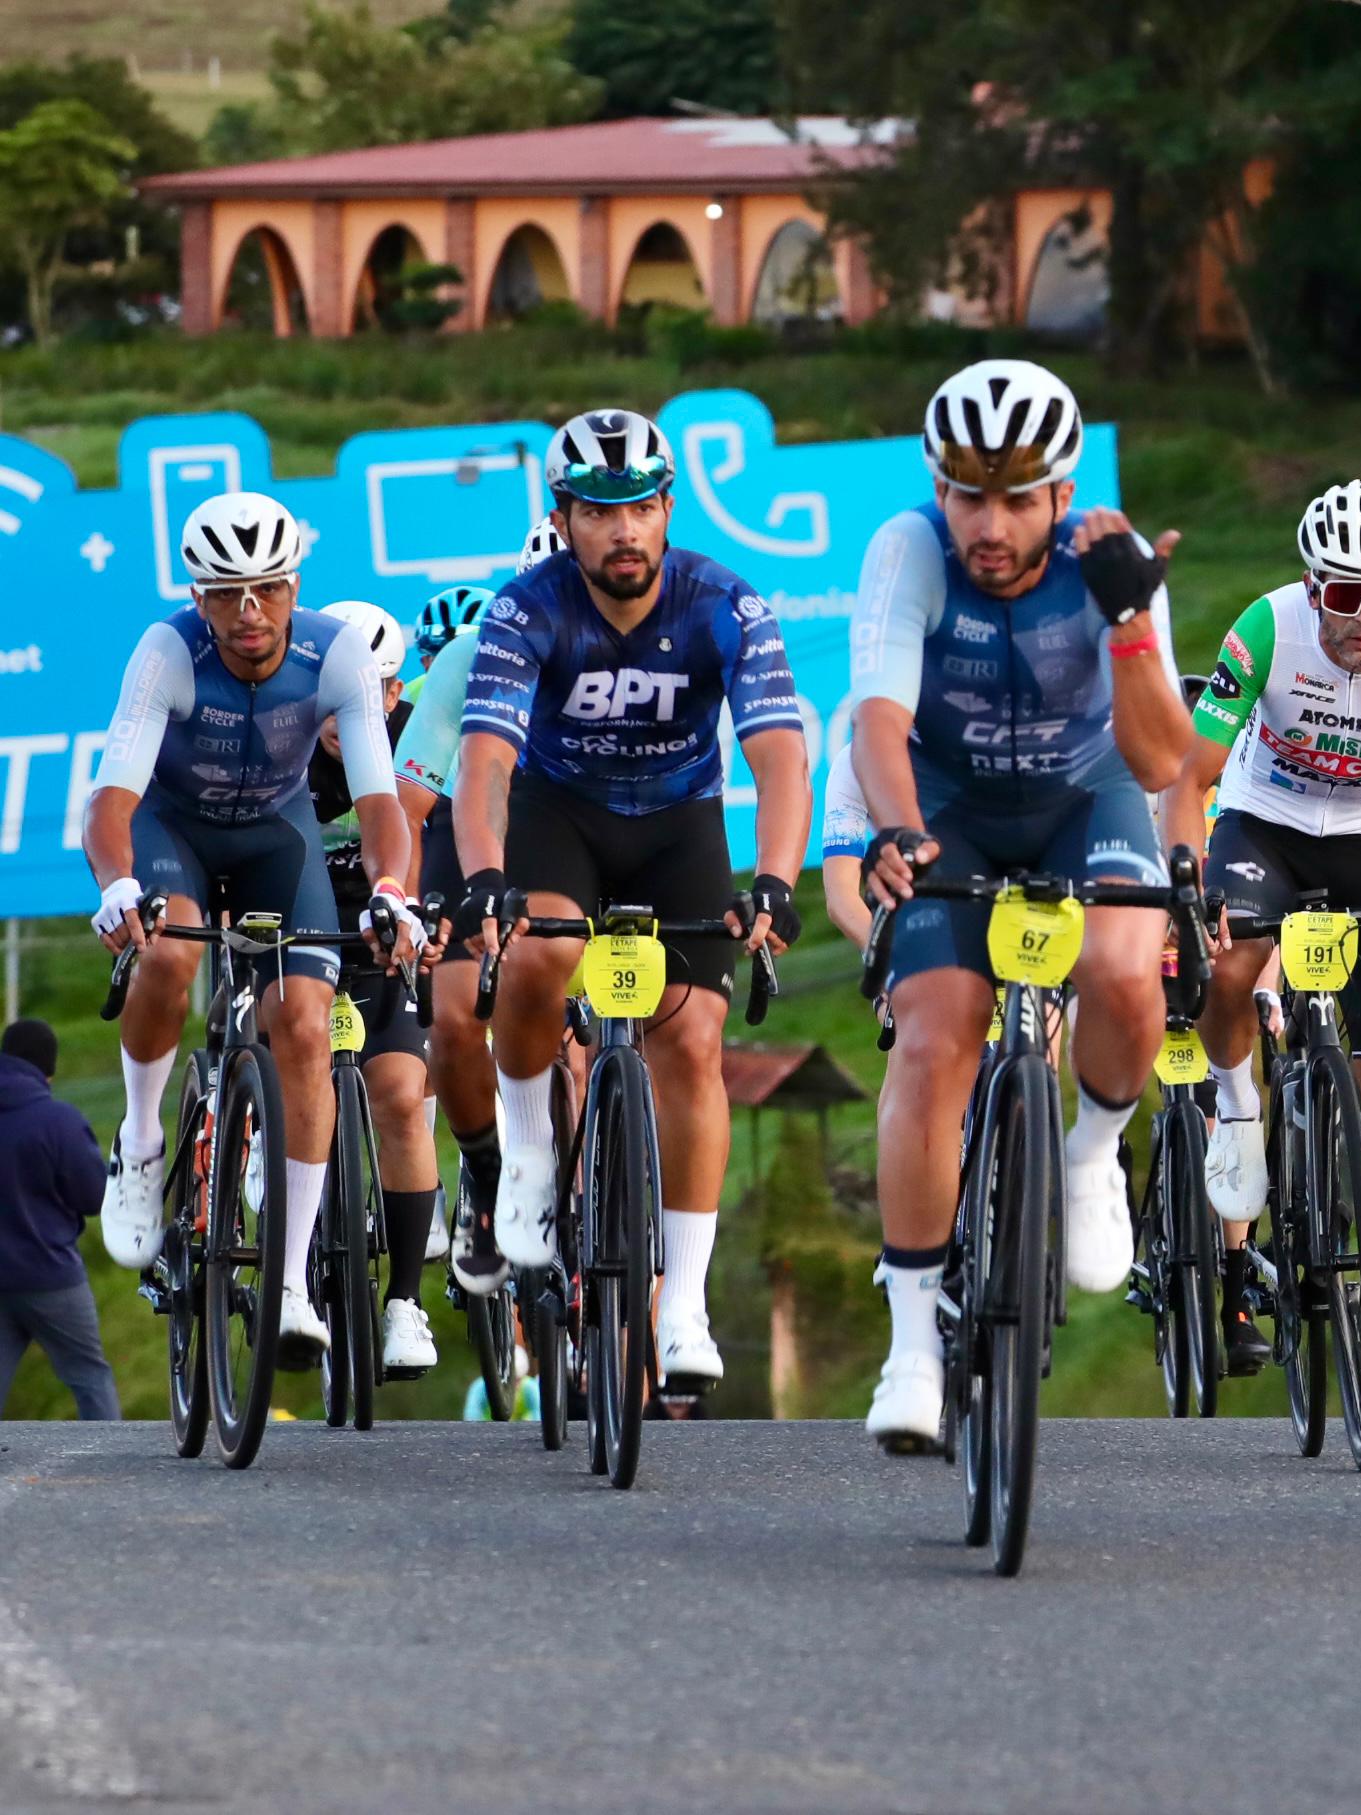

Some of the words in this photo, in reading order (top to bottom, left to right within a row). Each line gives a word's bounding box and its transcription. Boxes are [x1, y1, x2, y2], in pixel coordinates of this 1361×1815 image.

[953, 626, 989, 643] CYCLE
[561, 668, 689, 721] BPT
[200, 714, 236, 728] CYCLE
[202, 705, 245, 722] BORDER
[1262, 730, 1341, 772] TEAM
[1021, 929, 1051, 953] 67
[1303, 946, 1334, 964] 191
[612, 971, 637, 989] 39
[1168, 1049, 1194, 1064] 298
